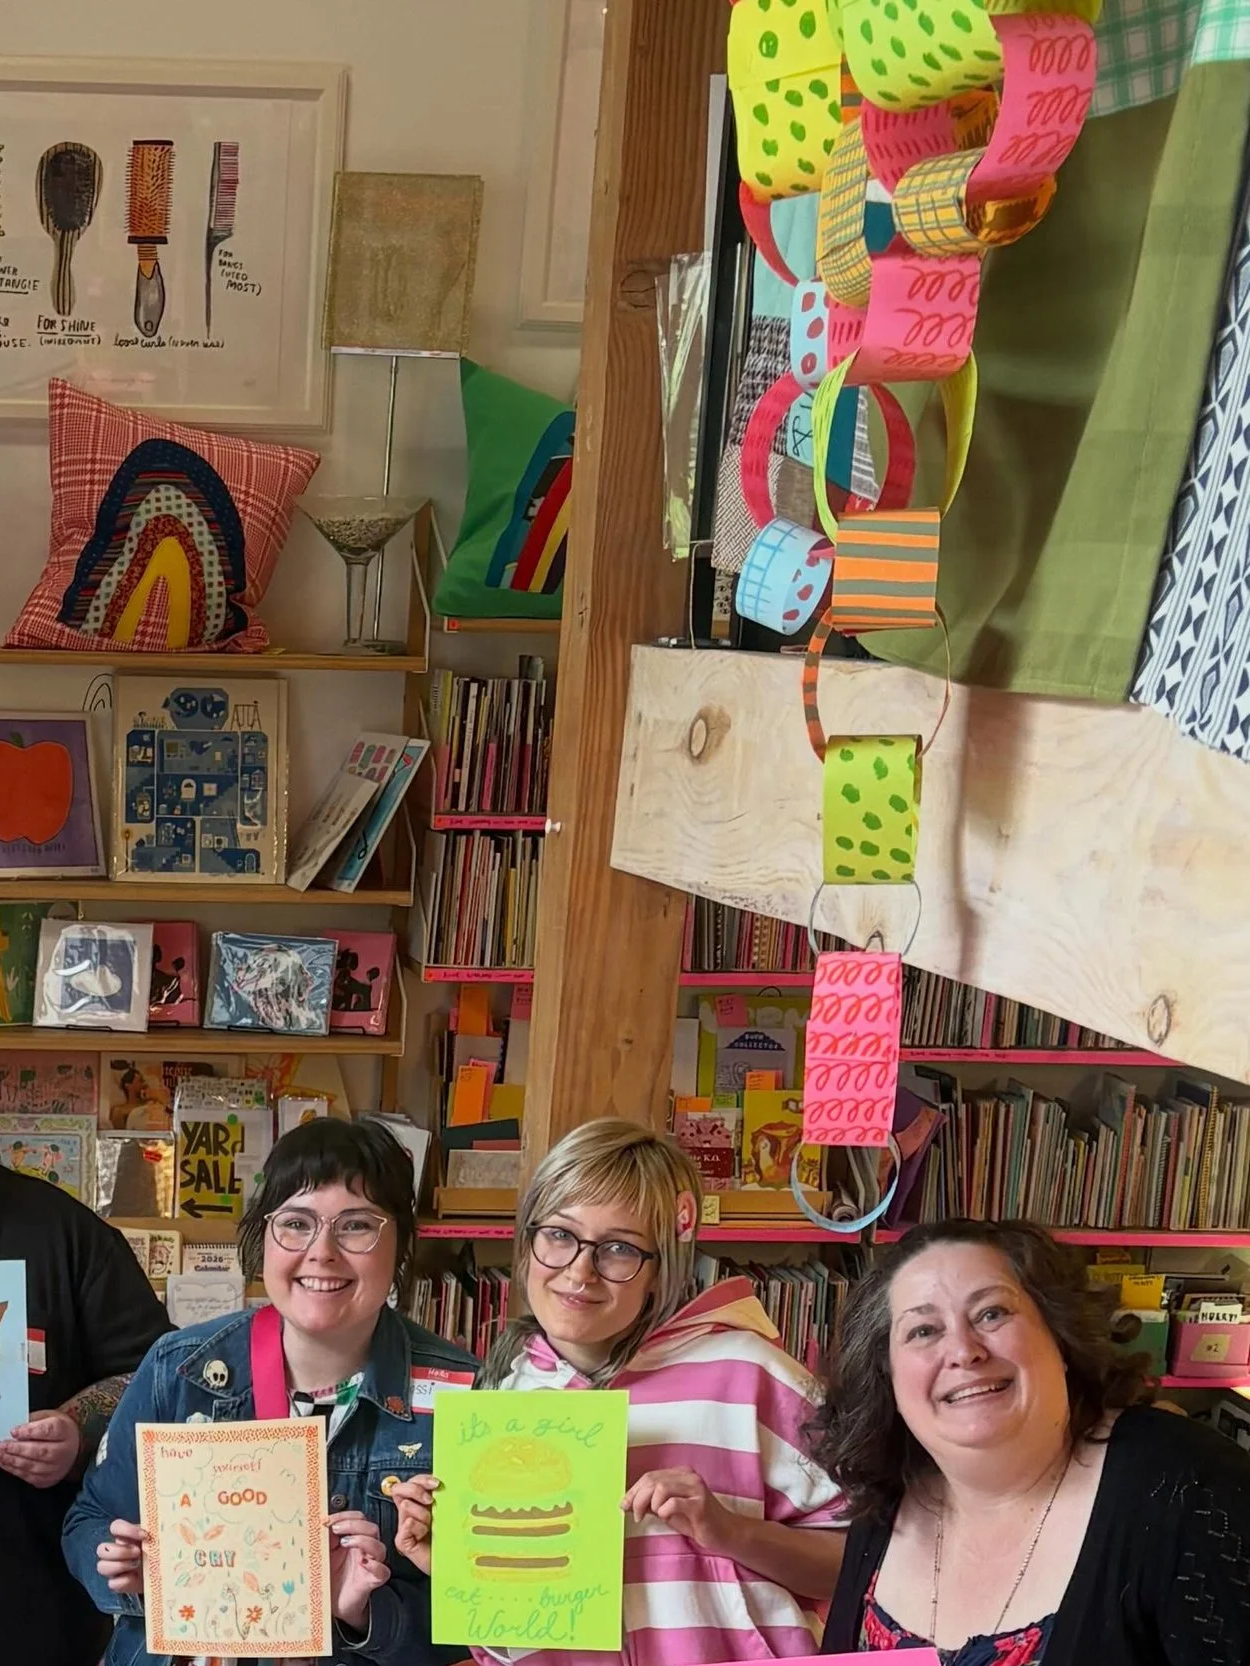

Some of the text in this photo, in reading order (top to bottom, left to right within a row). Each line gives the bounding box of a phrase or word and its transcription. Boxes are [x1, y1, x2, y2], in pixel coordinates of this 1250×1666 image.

[37, 315, 97, 332] FOR SHINE
[180, 1159, 242, 1195] SALE
[201, 1255, 224, 1264] 2026
[506, 1418, 525, 1432] a
[179, 1487, 268, 1508] A GOOD
[539, 1583, 610, 1615] burger
